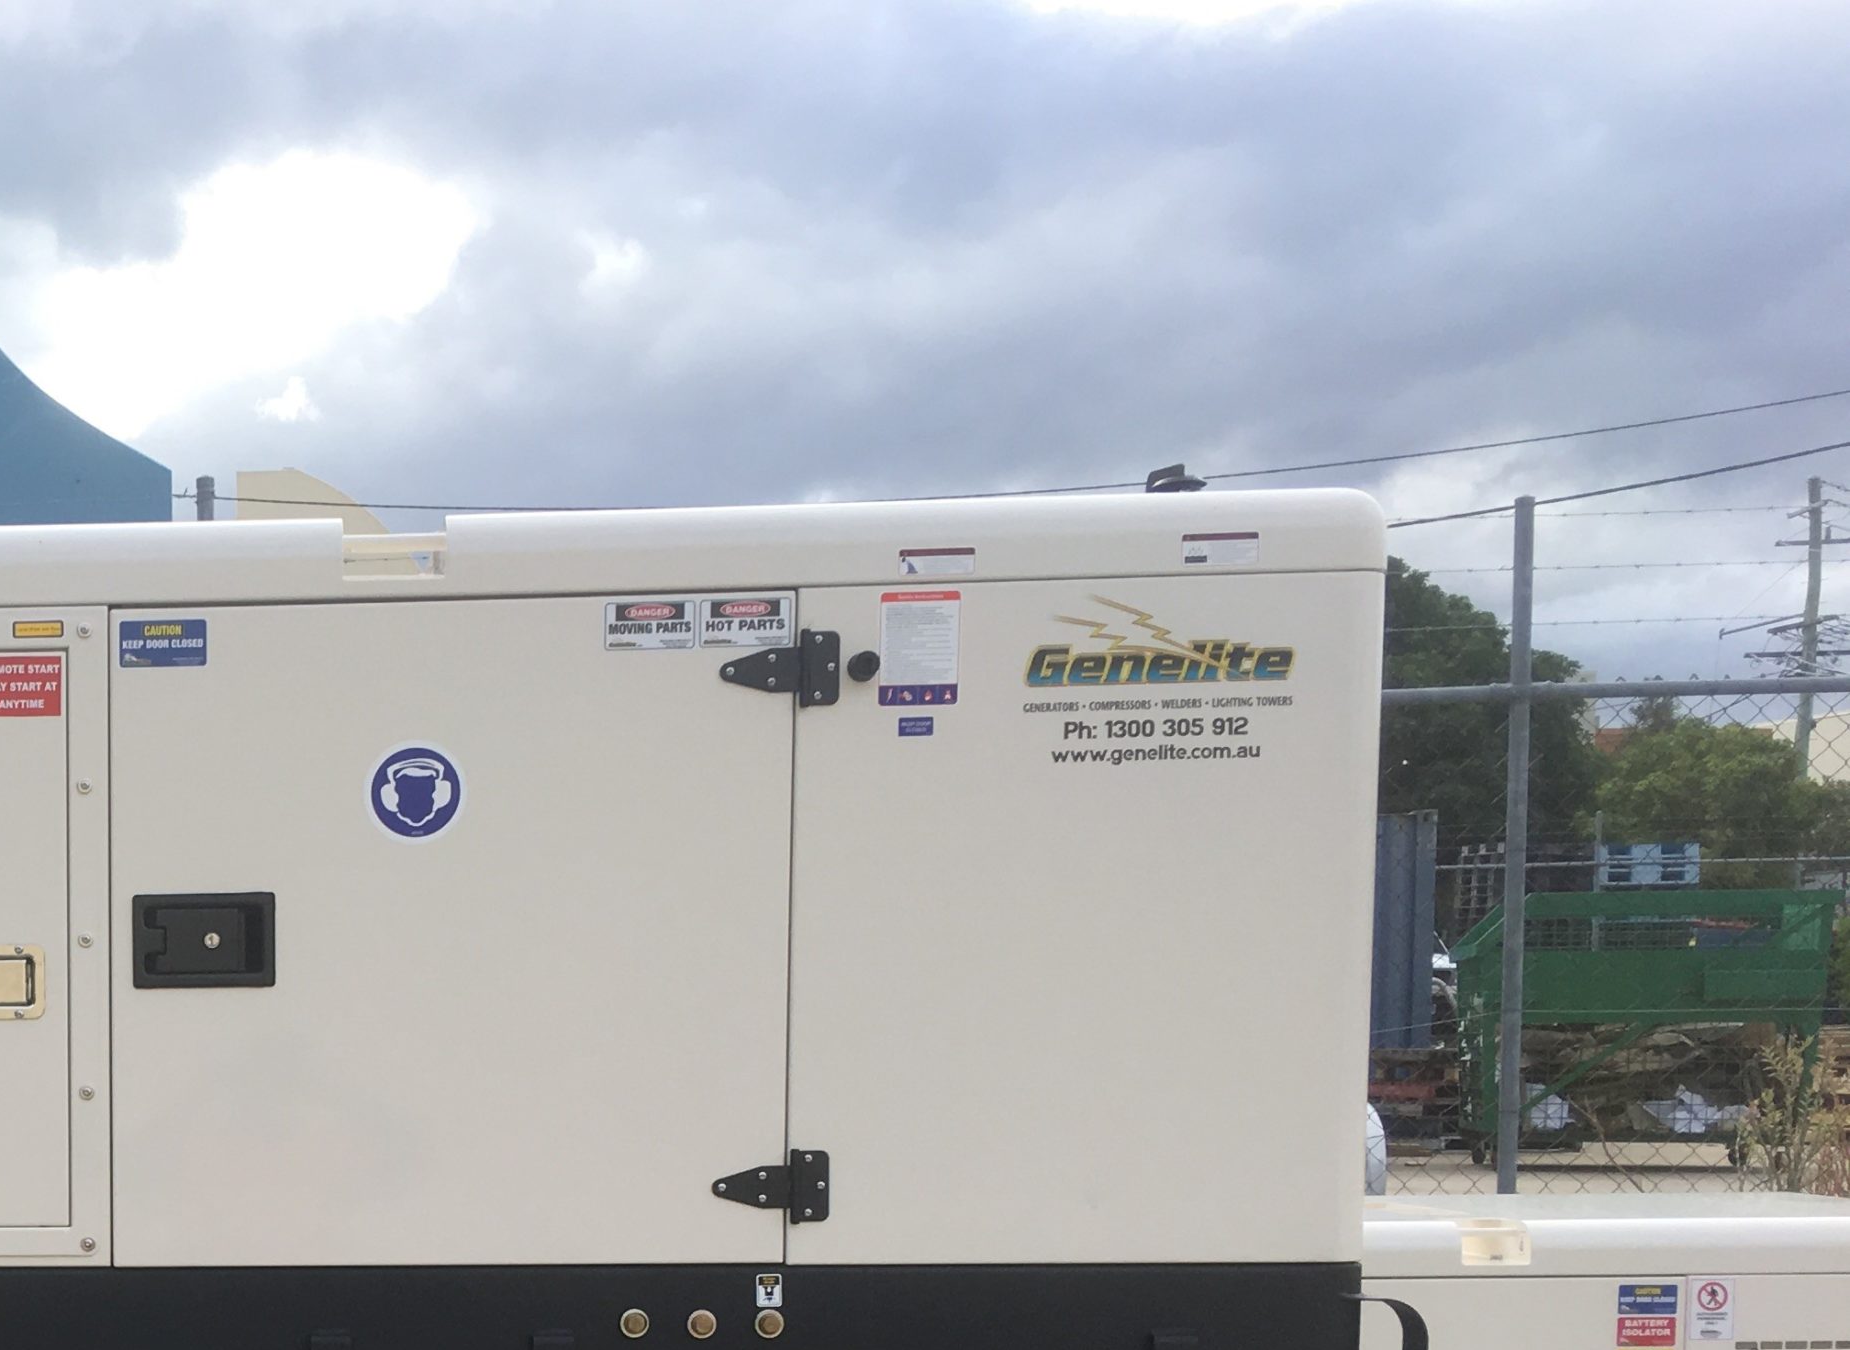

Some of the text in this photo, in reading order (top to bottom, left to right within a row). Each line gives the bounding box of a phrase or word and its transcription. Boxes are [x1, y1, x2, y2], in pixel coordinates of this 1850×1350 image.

[630, 608, 670, 617] DANGER
[725, 605, 766, 614] DANGER
[144, 624, 182, 636] CAUTION
[608, 621, 691, 635] MOVING PARTS
[705, 618, 785, 632] HOT PARTS
[122, 638, 204, 649] KEEP DOOR CLOSED
[27, 664, 60, 674] START
[1024, 639, 1297, 687] Genelite
[9, 682, 42, 691] START
[44, 682, 57, 691] AT
[1023, 695, 1293, 713] GENERATORS COMPRESSORS WELDERS LIGHTING TOWERS
[1063, 716, 1249, 739] Ph: 1300 305 912
[1051, 744, 1261, 766] www.genelite.com.au
[1622, 1328, 1671, 1337] ISOLATOR
